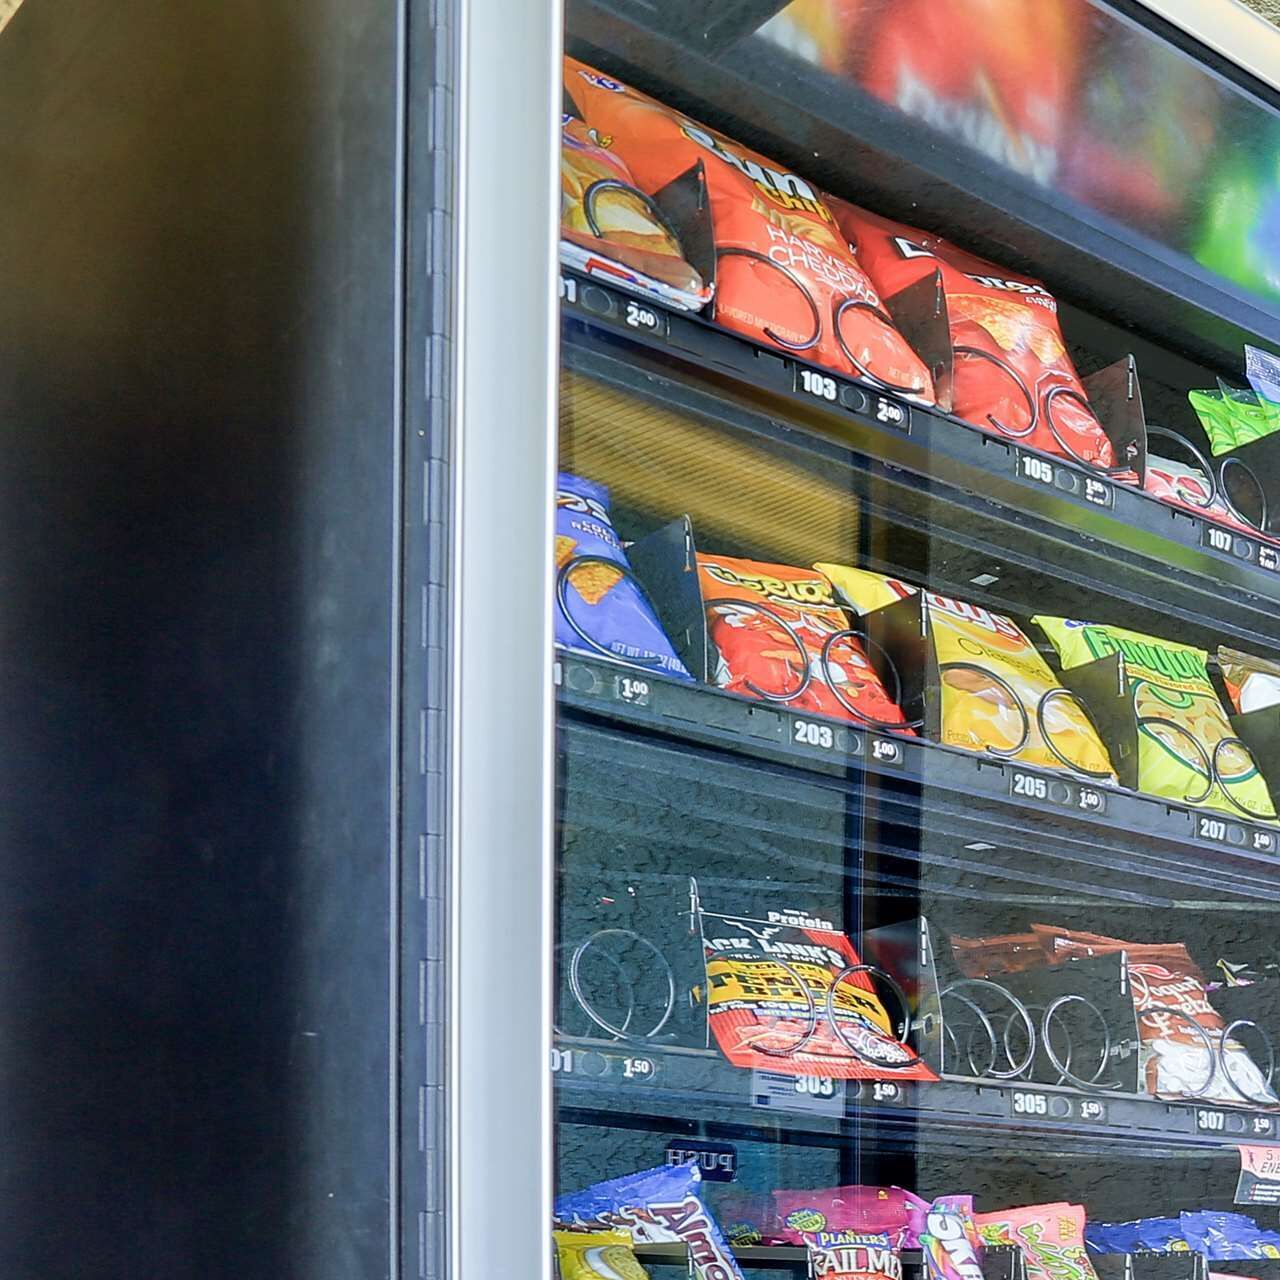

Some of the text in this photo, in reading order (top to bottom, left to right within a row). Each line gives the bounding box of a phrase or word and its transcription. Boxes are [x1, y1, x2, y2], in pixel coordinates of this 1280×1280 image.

[800, 370, 837, 400] 103
[1022, 464, 1052, 484] 105
[1208, 528, 1232, 551] 107
[795, 720, 832, 749] 203
[1014, 773, 1047, 799] 205
[1200, 817, 1225, 838] 207
[768, 911, 833, 930] Protein
[757, 938, 846, 968] LINK'S
[623, 1058, 649, 1077] 1.50
[796, 1075, 896, 1100] 303 1.50
[1015, 1093, 1047, 1114] 305
[1199, 1110, 1224, 1131] 307
[820, 1231, 890, 1250] PLANTERS
[813, 1246, 868, 1275] RAIL
